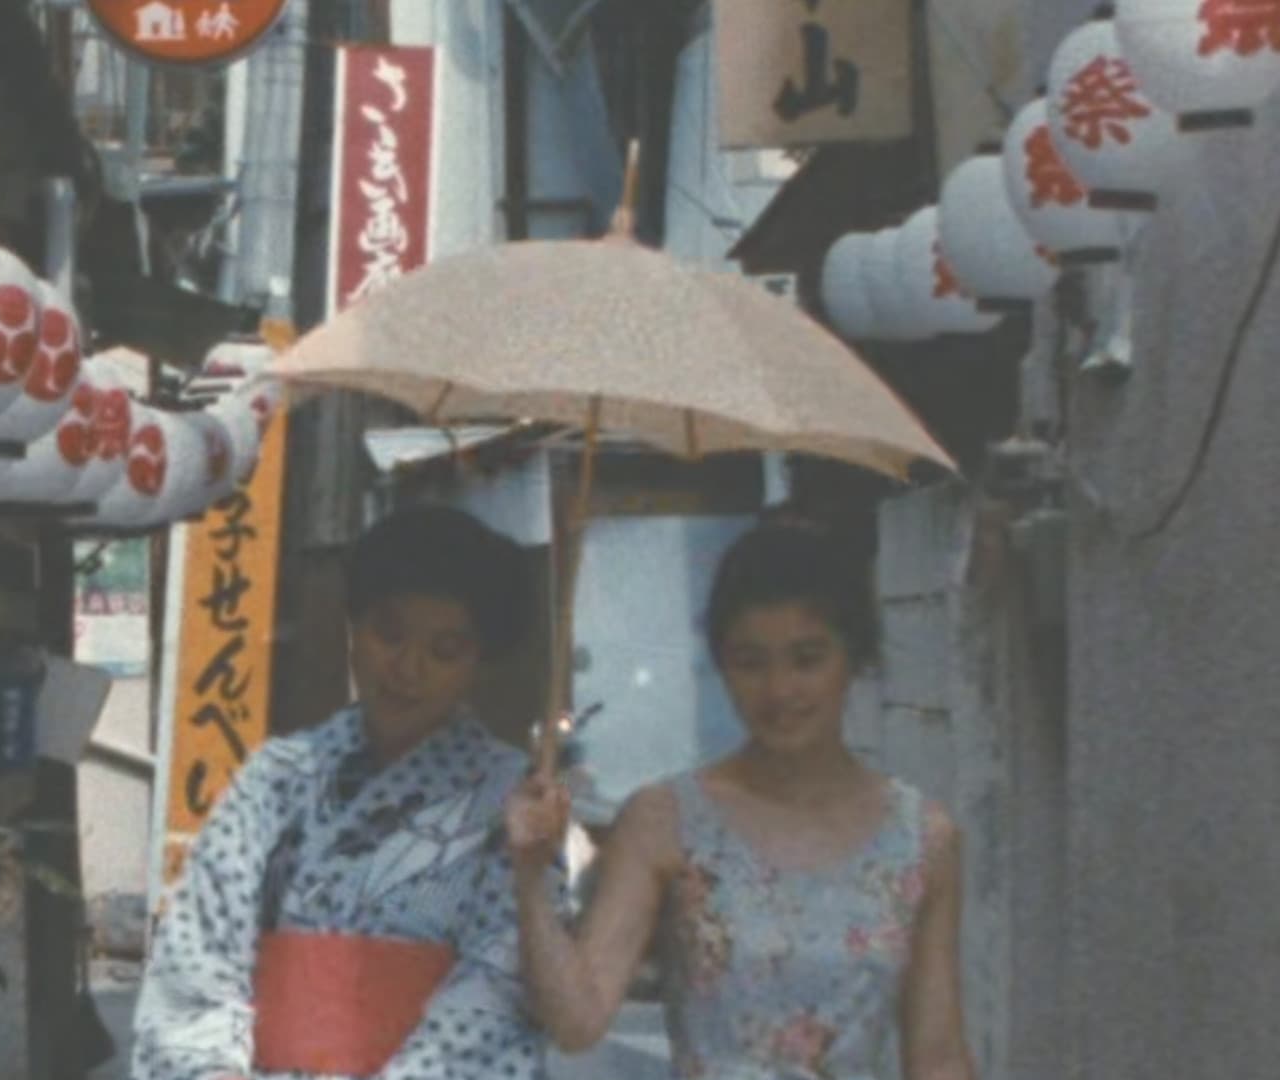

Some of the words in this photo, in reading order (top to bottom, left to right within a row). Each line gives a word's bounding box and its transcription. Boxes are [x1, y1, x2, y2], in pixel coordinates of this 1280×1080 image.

[773, 0, 861, 123] 山
[1062, 54, 1154, 149] 祭
[186, 476, 257, 816] 子せんべい
